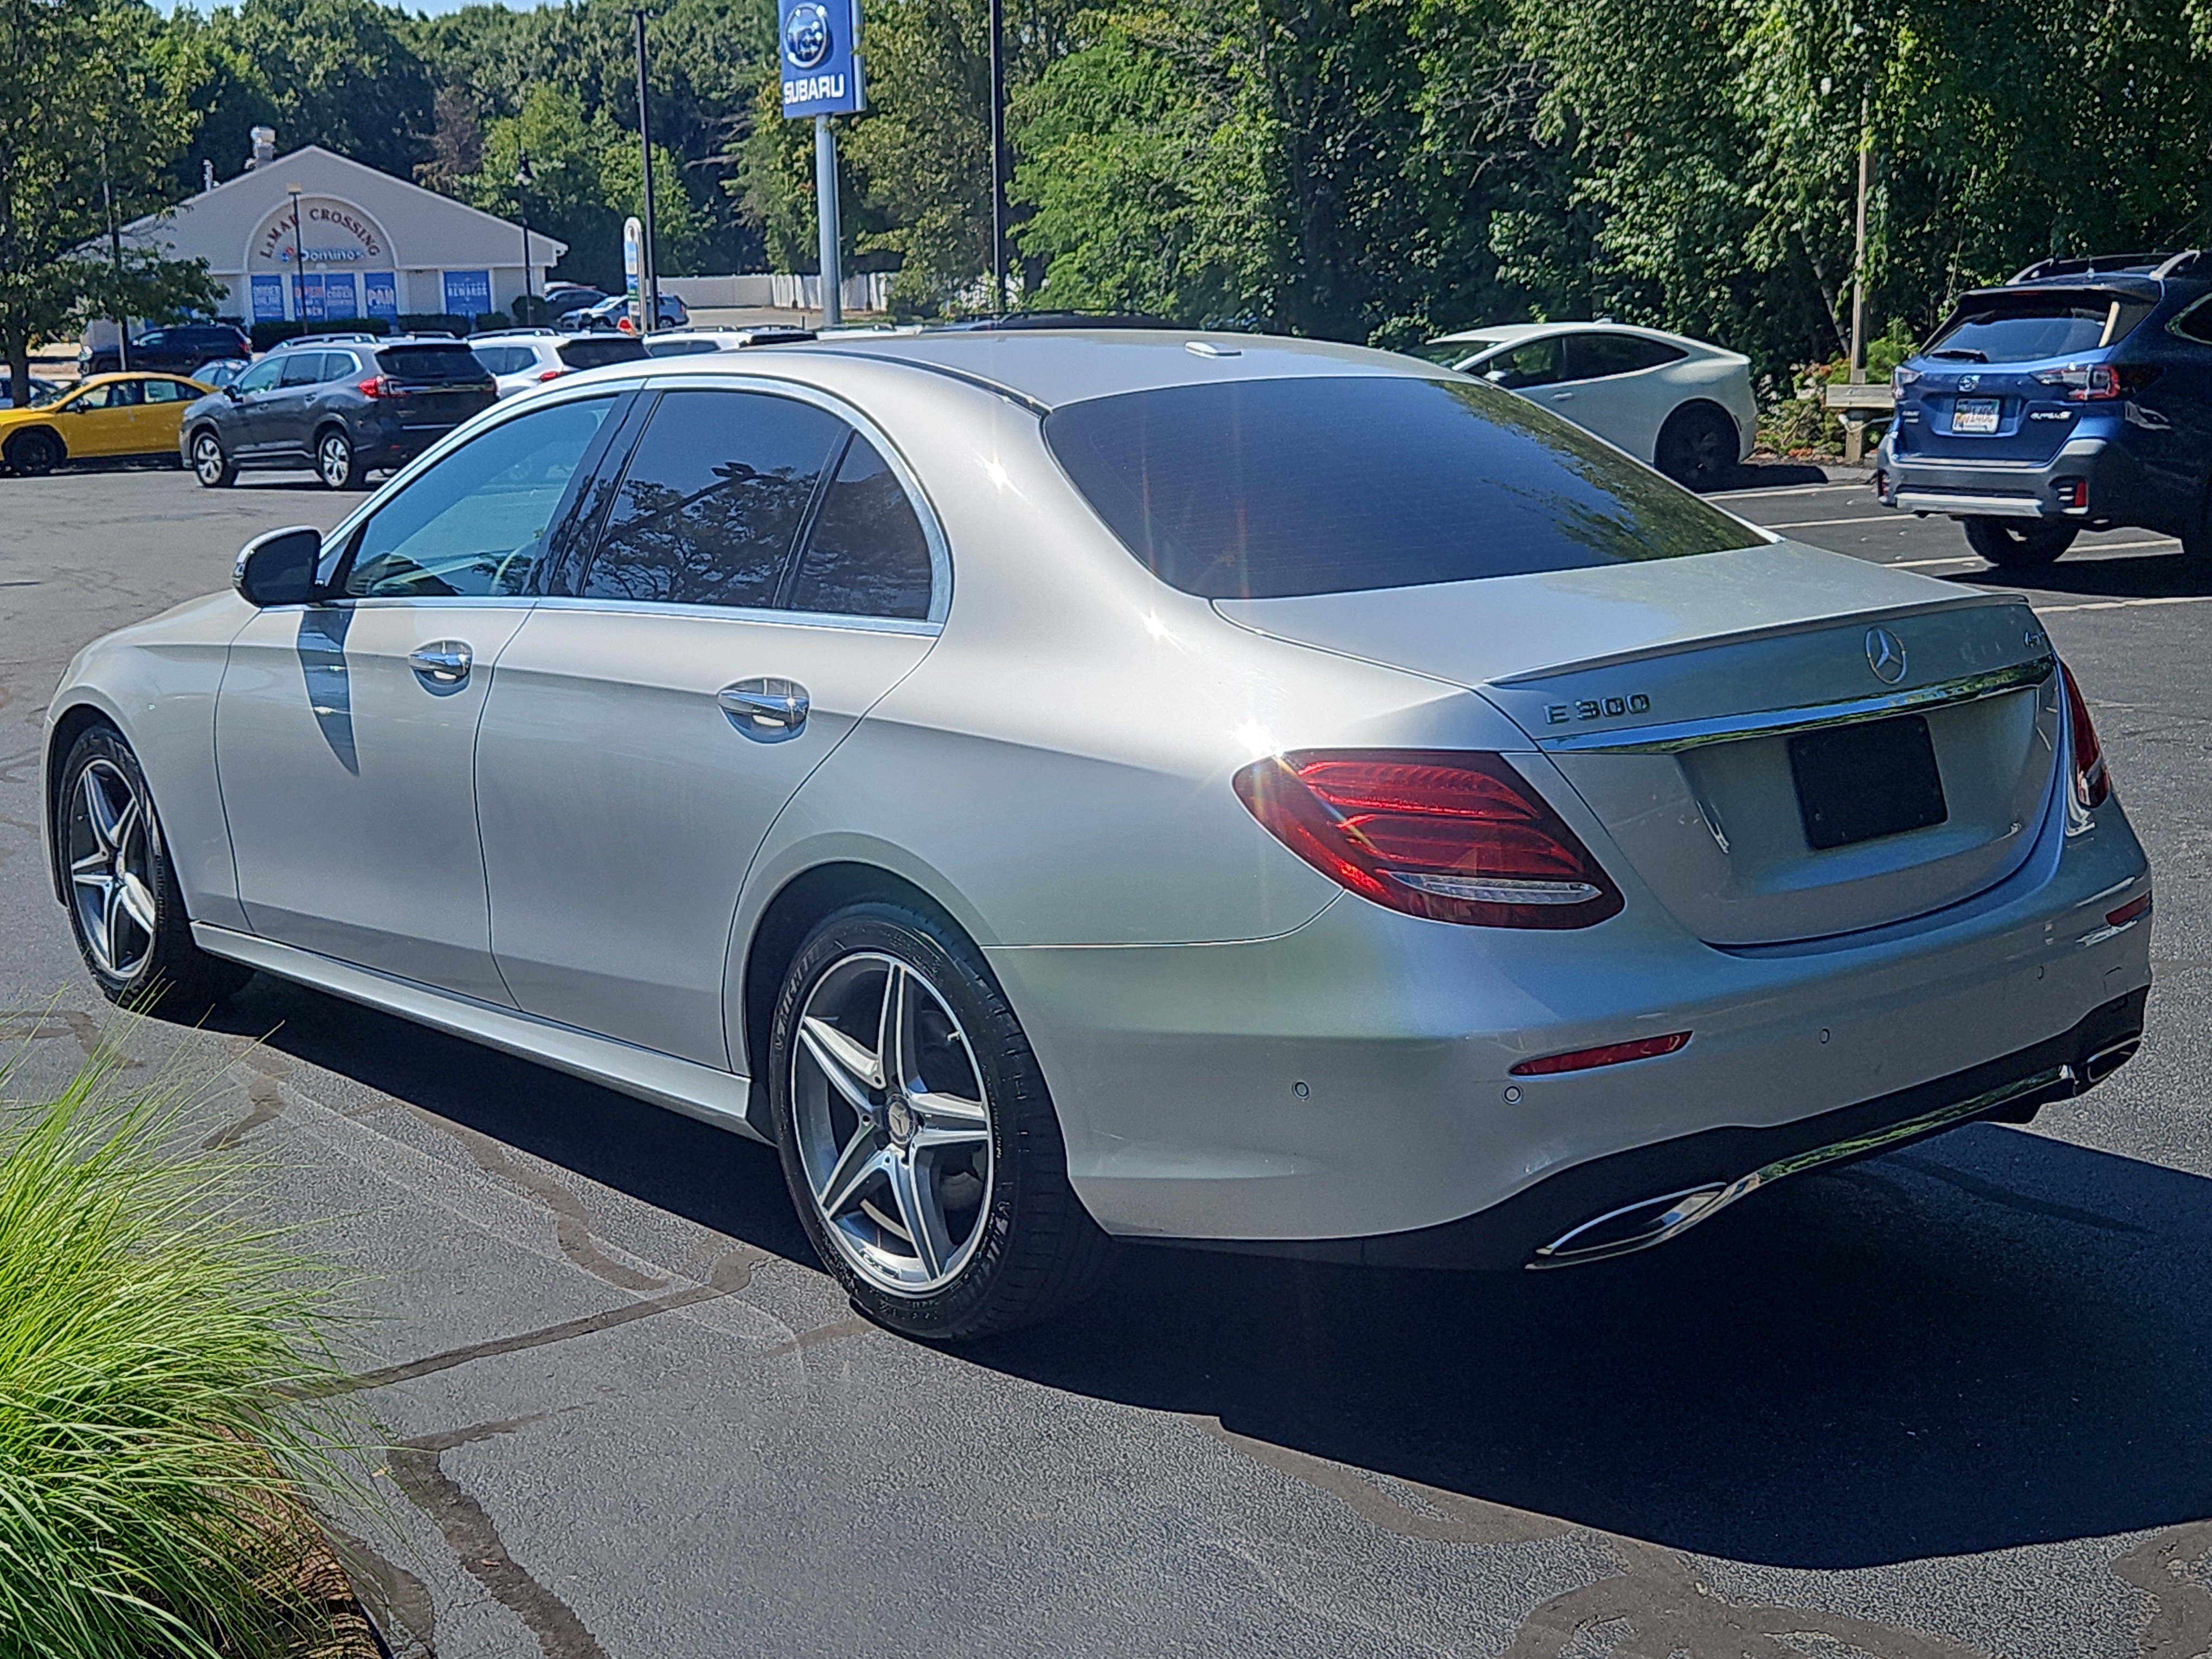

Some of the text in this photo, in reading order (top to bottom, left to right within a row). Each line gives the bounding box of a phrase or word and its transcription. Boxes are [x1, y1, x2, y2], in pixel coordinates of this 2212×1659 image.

[783, 73, 844, 105] SUBARU
[309, 208, 380, 256] CROSSING
[1543, 693, 1651, 724] E 300
